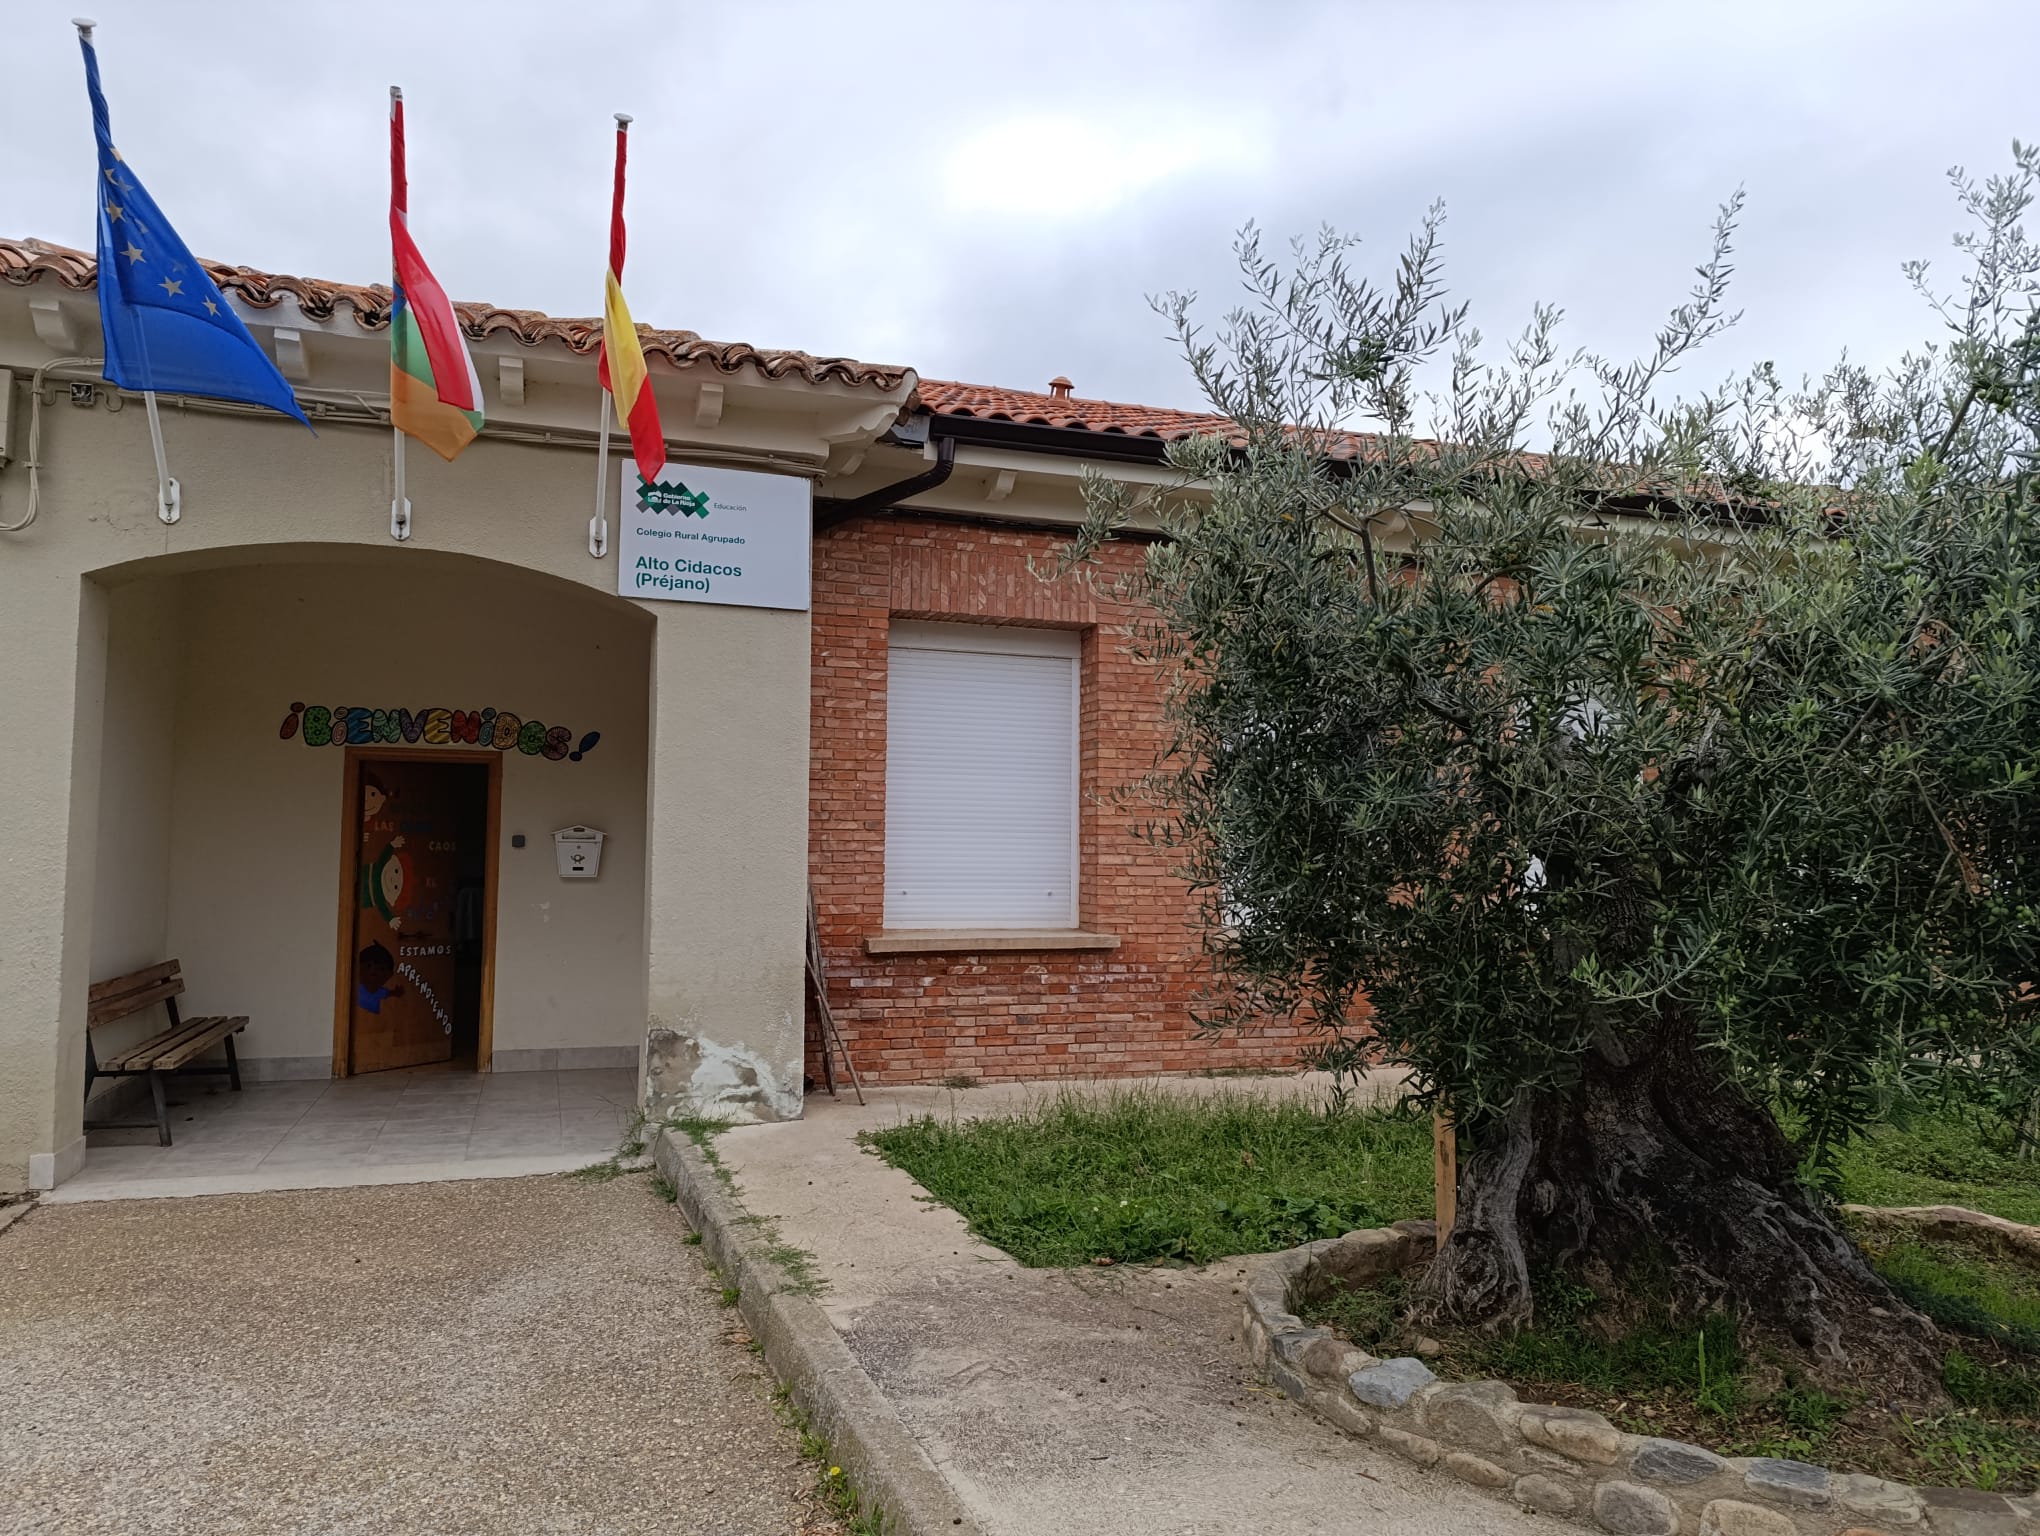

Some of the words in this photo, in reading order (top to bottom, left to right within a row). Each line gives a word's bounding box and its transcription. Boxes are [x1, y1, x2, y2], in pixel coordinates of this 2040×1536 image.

[713, 503, 747, 512] Educación
[636, 527, 672, 538] Colegio
[674, 530, 699, 540] Rural
[701, 533, 746, 544] Agrupado
[635, 556, 669, 571] Alto
[674, 559, 742, 577] Cidacos
[635, 572, 710, 593] (Préjano)
[399, 945, 452, 956] ESTAMOS
